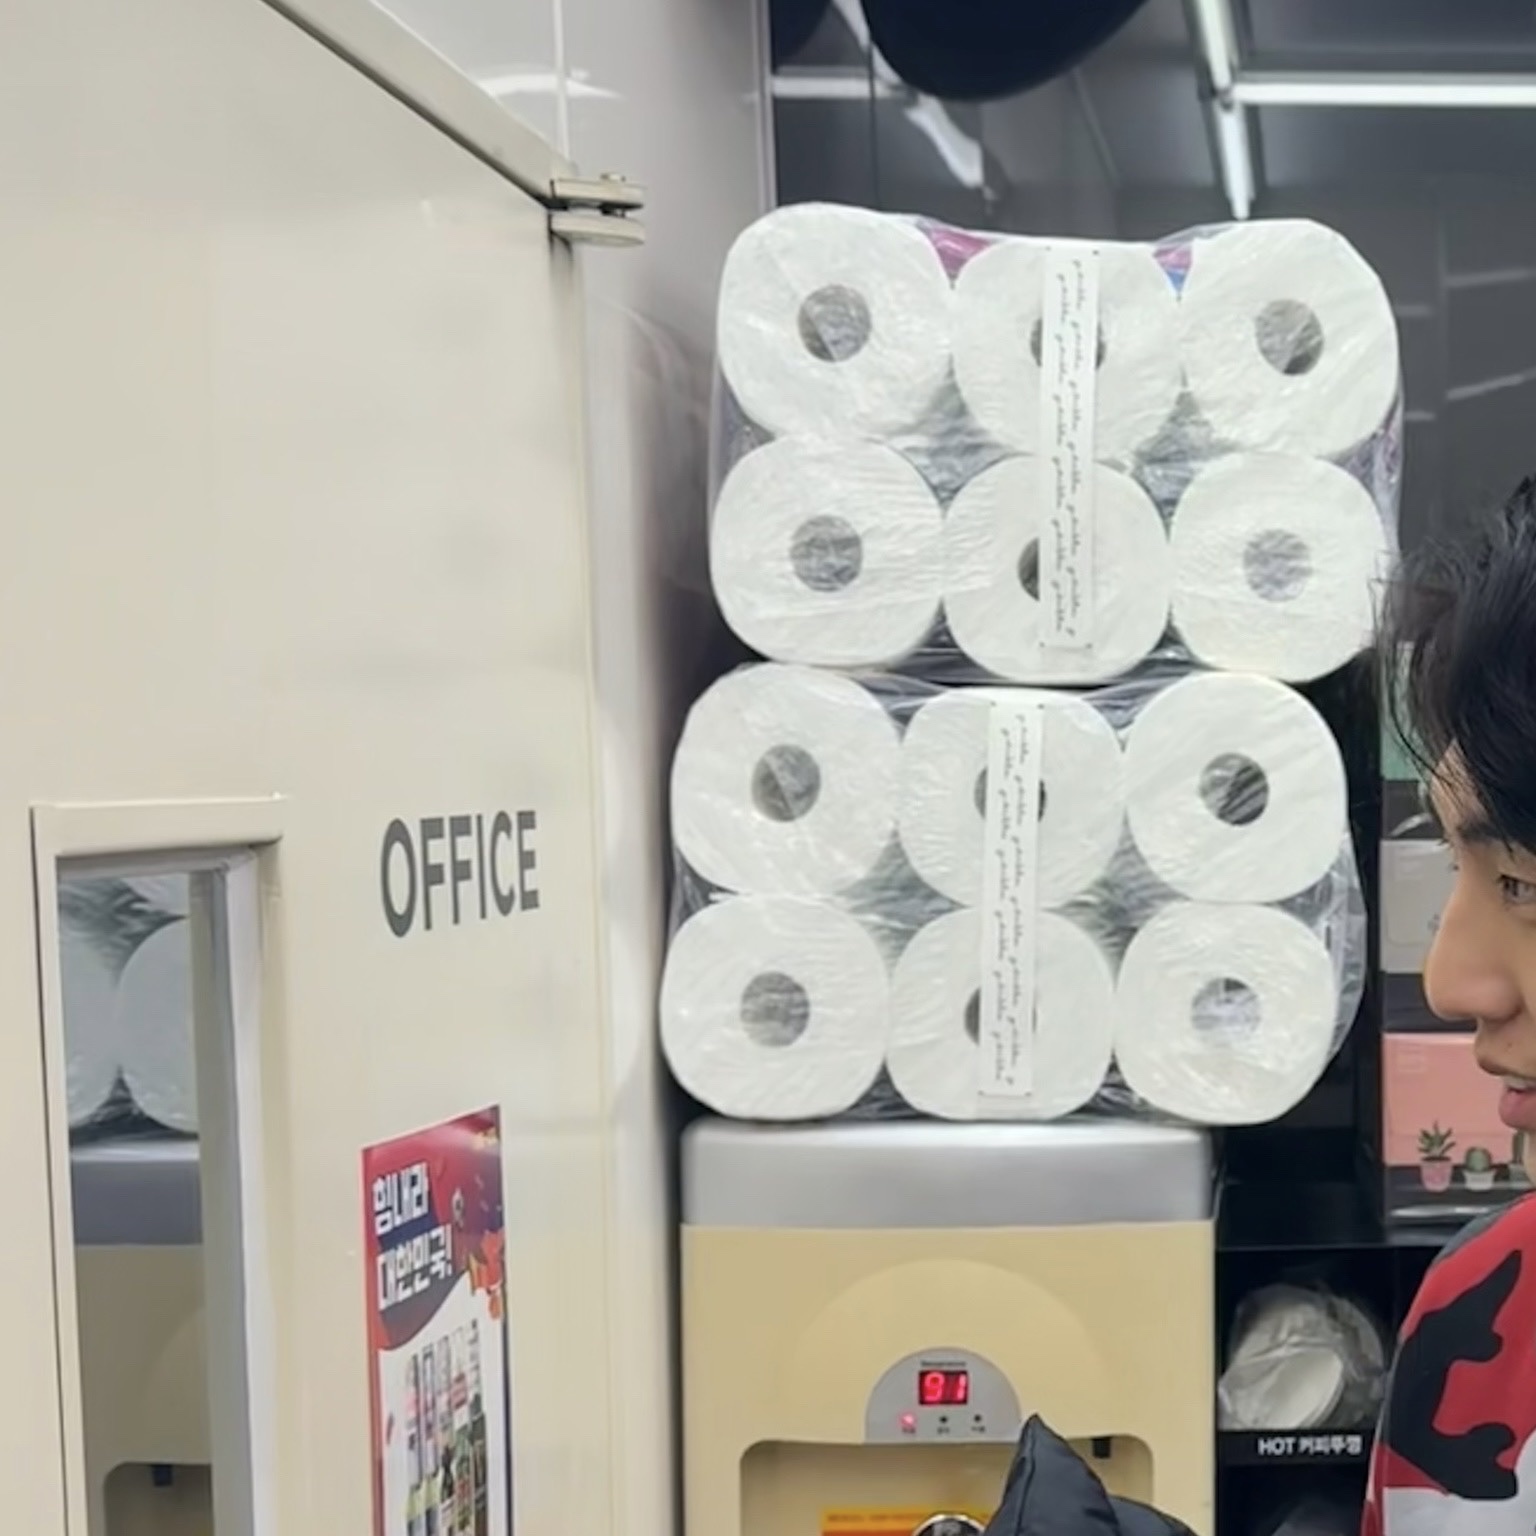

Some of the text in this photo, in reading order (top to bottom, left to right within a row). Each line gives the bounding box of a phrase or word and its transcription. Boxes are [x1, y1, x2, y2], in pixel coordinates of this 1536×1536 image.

[380, 810, 540, 938] OFFICE
[372, 1161, 430, 1236] 힘내라
[376, 1222, 454, 1311] 대한민국!
[924, 1371, 967, 1402] 91
[1257, 1436, 1297, 1456] HOT
